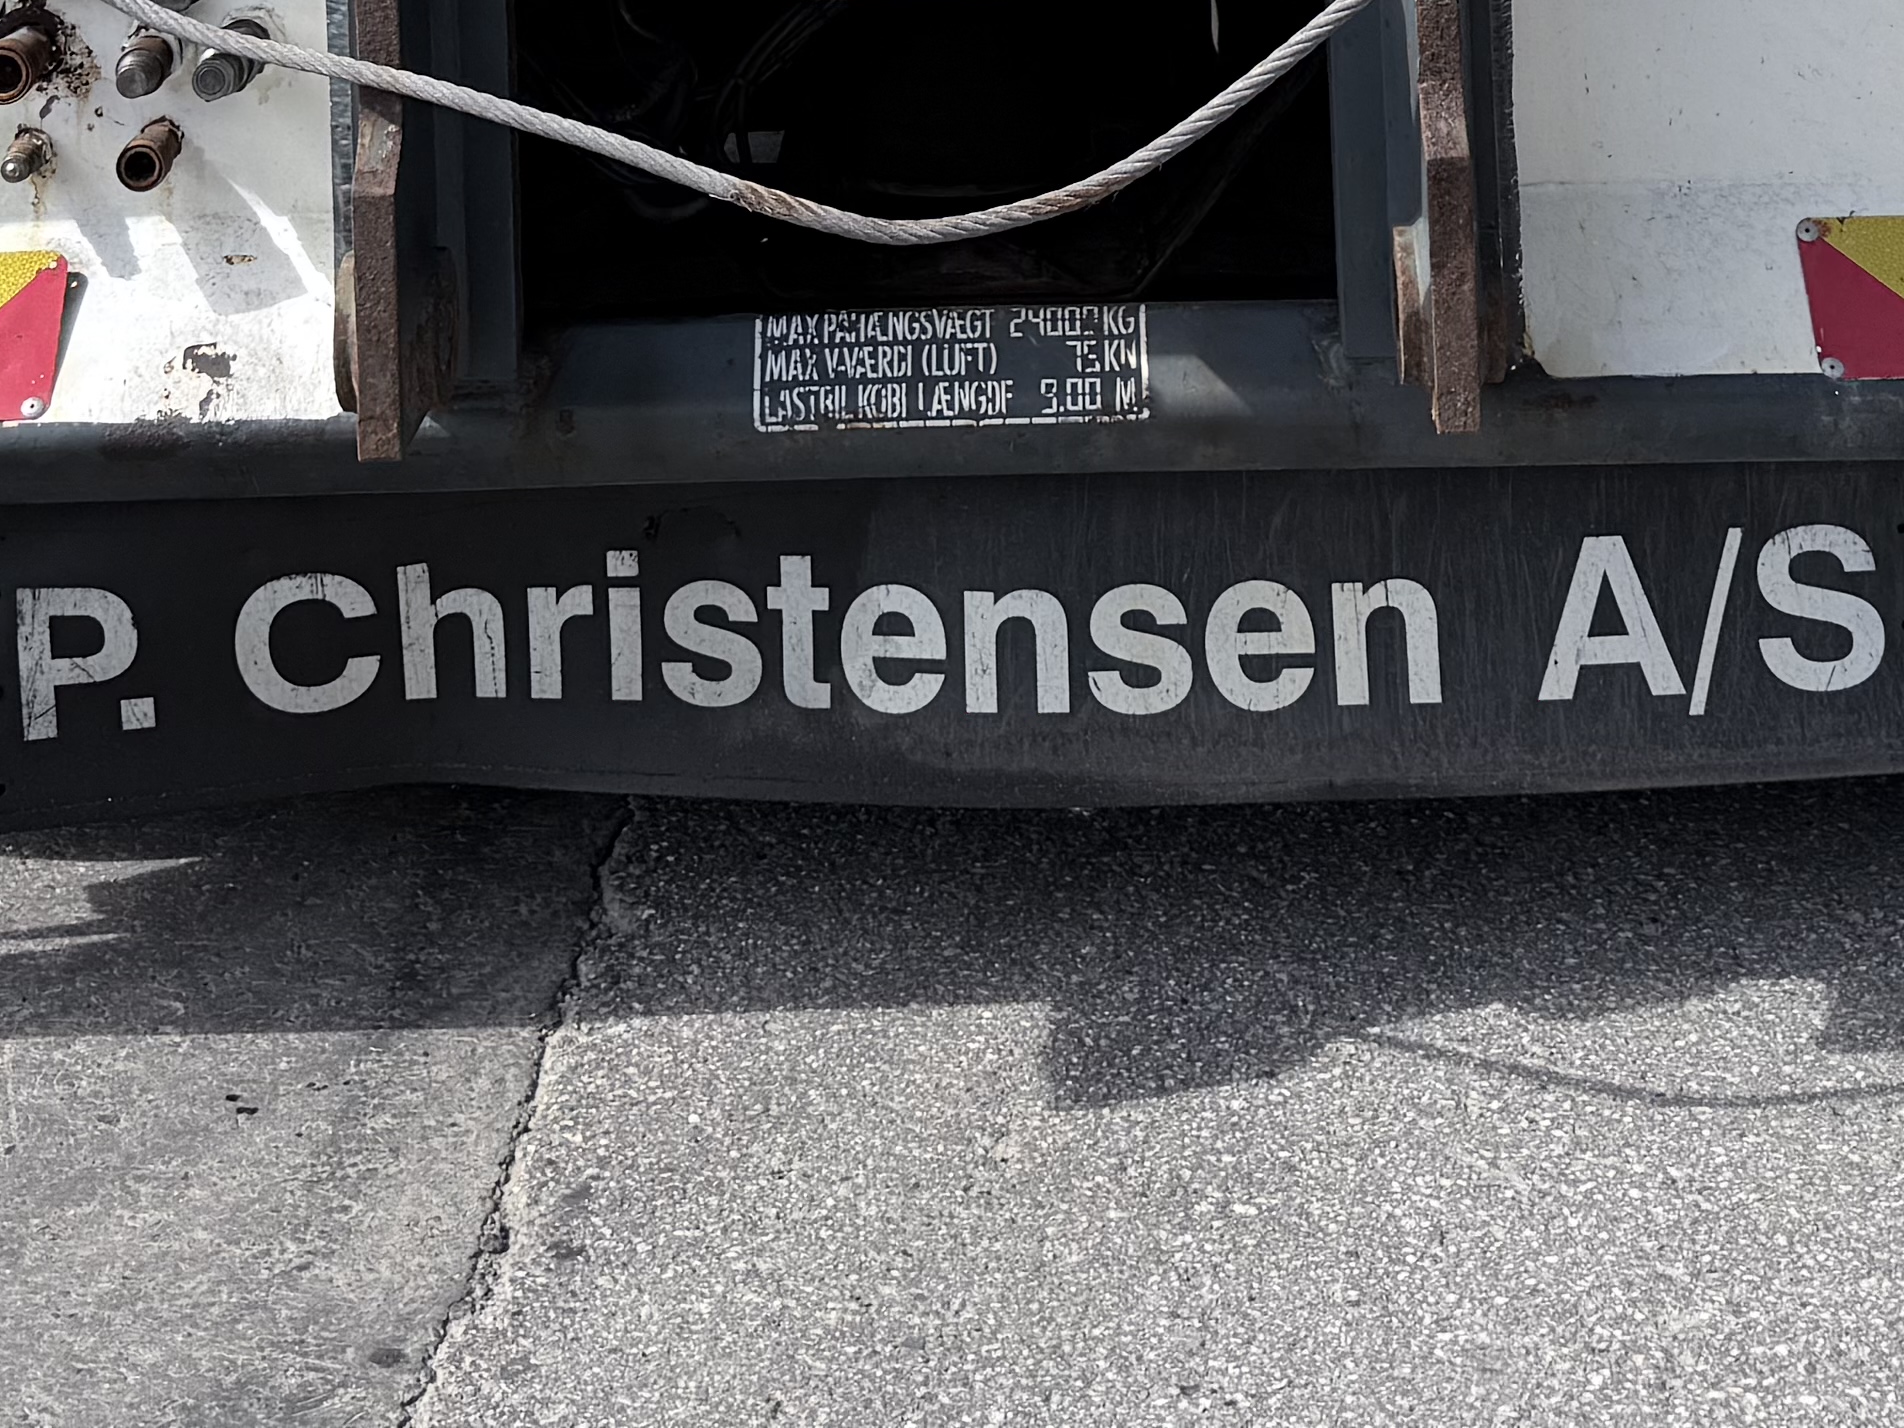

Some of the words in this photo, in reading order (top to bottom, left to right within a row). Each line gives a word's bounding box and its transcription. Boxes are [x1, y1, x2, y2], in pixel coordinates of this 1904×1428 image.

[767, 314, 819, 346] MAX
[1103, 305, 1135, 336] KG
[765, 348, 819, 382] MAX
[922, 342, 997, 376] (LUFT)
[1066, 340, 1100, 372] 75
[1104, 339, 1137, 372] KN
[14, 586, 157, 742] P.
[234, 550, 1443, 716] Christensen
[1539, 523, 1888, 716] A/S
